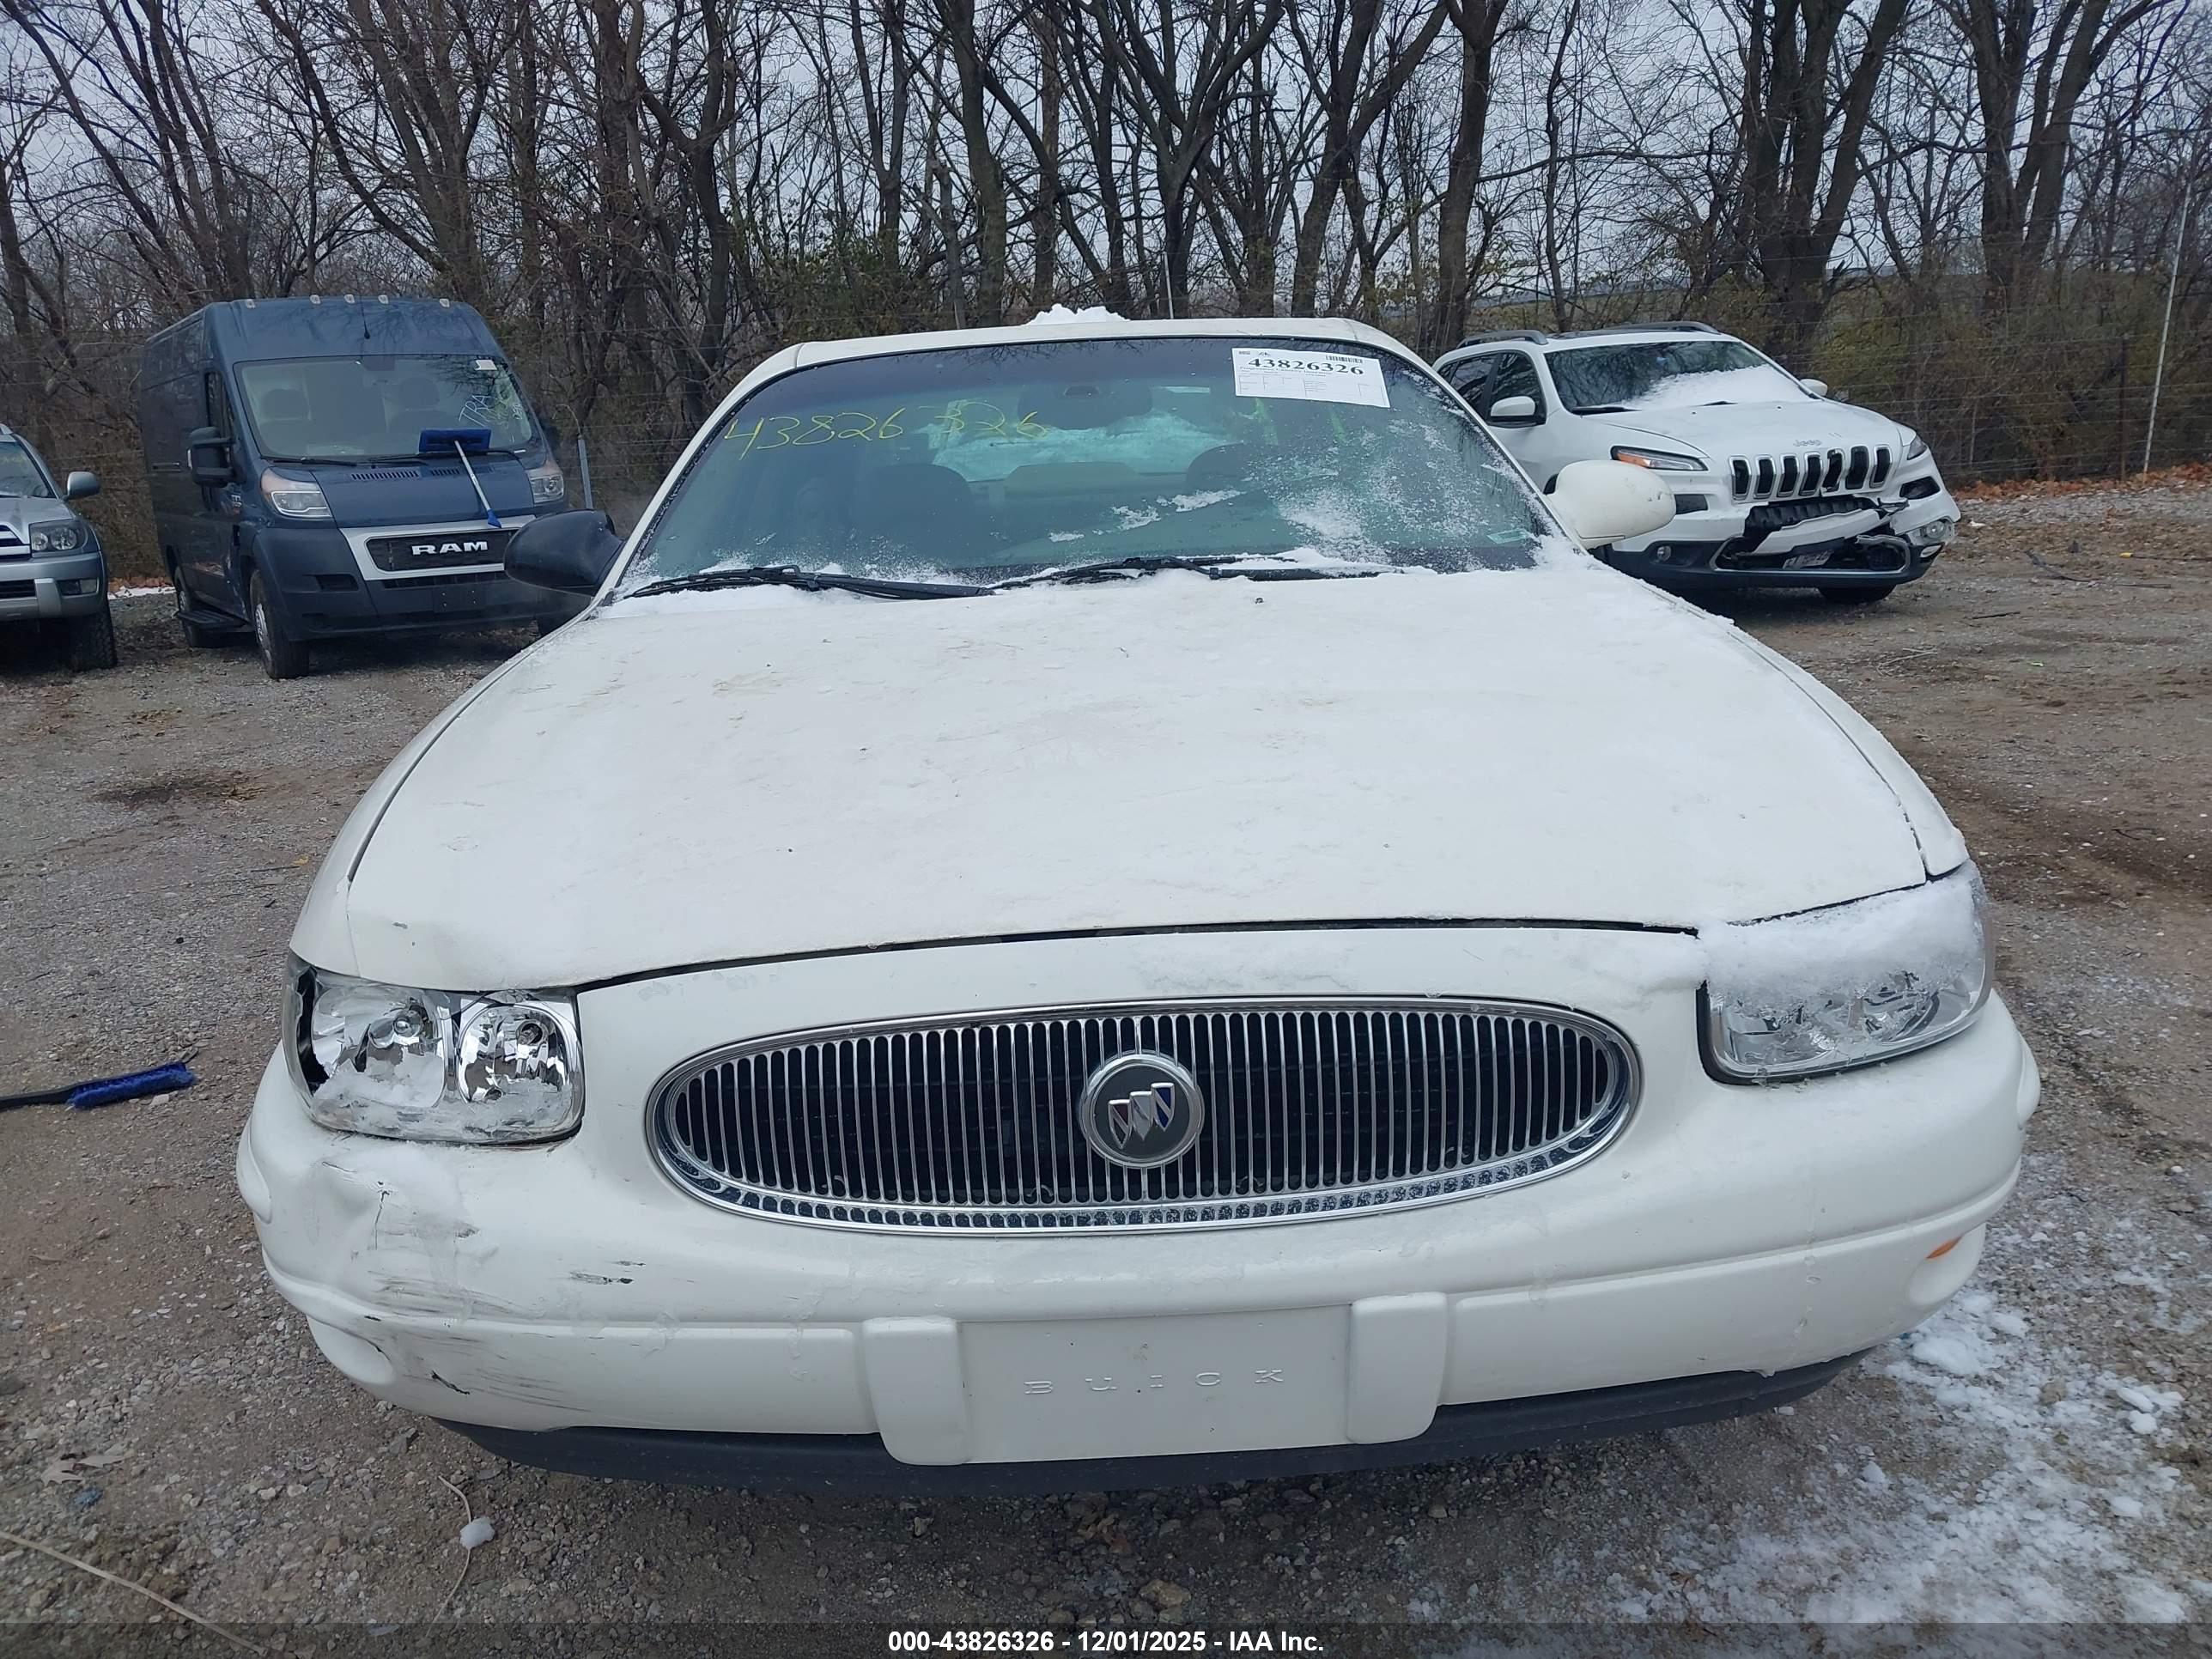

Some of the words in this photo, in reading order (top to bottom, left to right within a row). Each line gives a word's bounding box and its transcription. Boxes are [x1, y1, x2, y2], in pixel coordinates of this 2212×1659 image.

[1248, 357, 1365, 376] 43826326
[411, 541, 489, 556] RAM
[1024, 1369, 1285, 1395] BUICK
